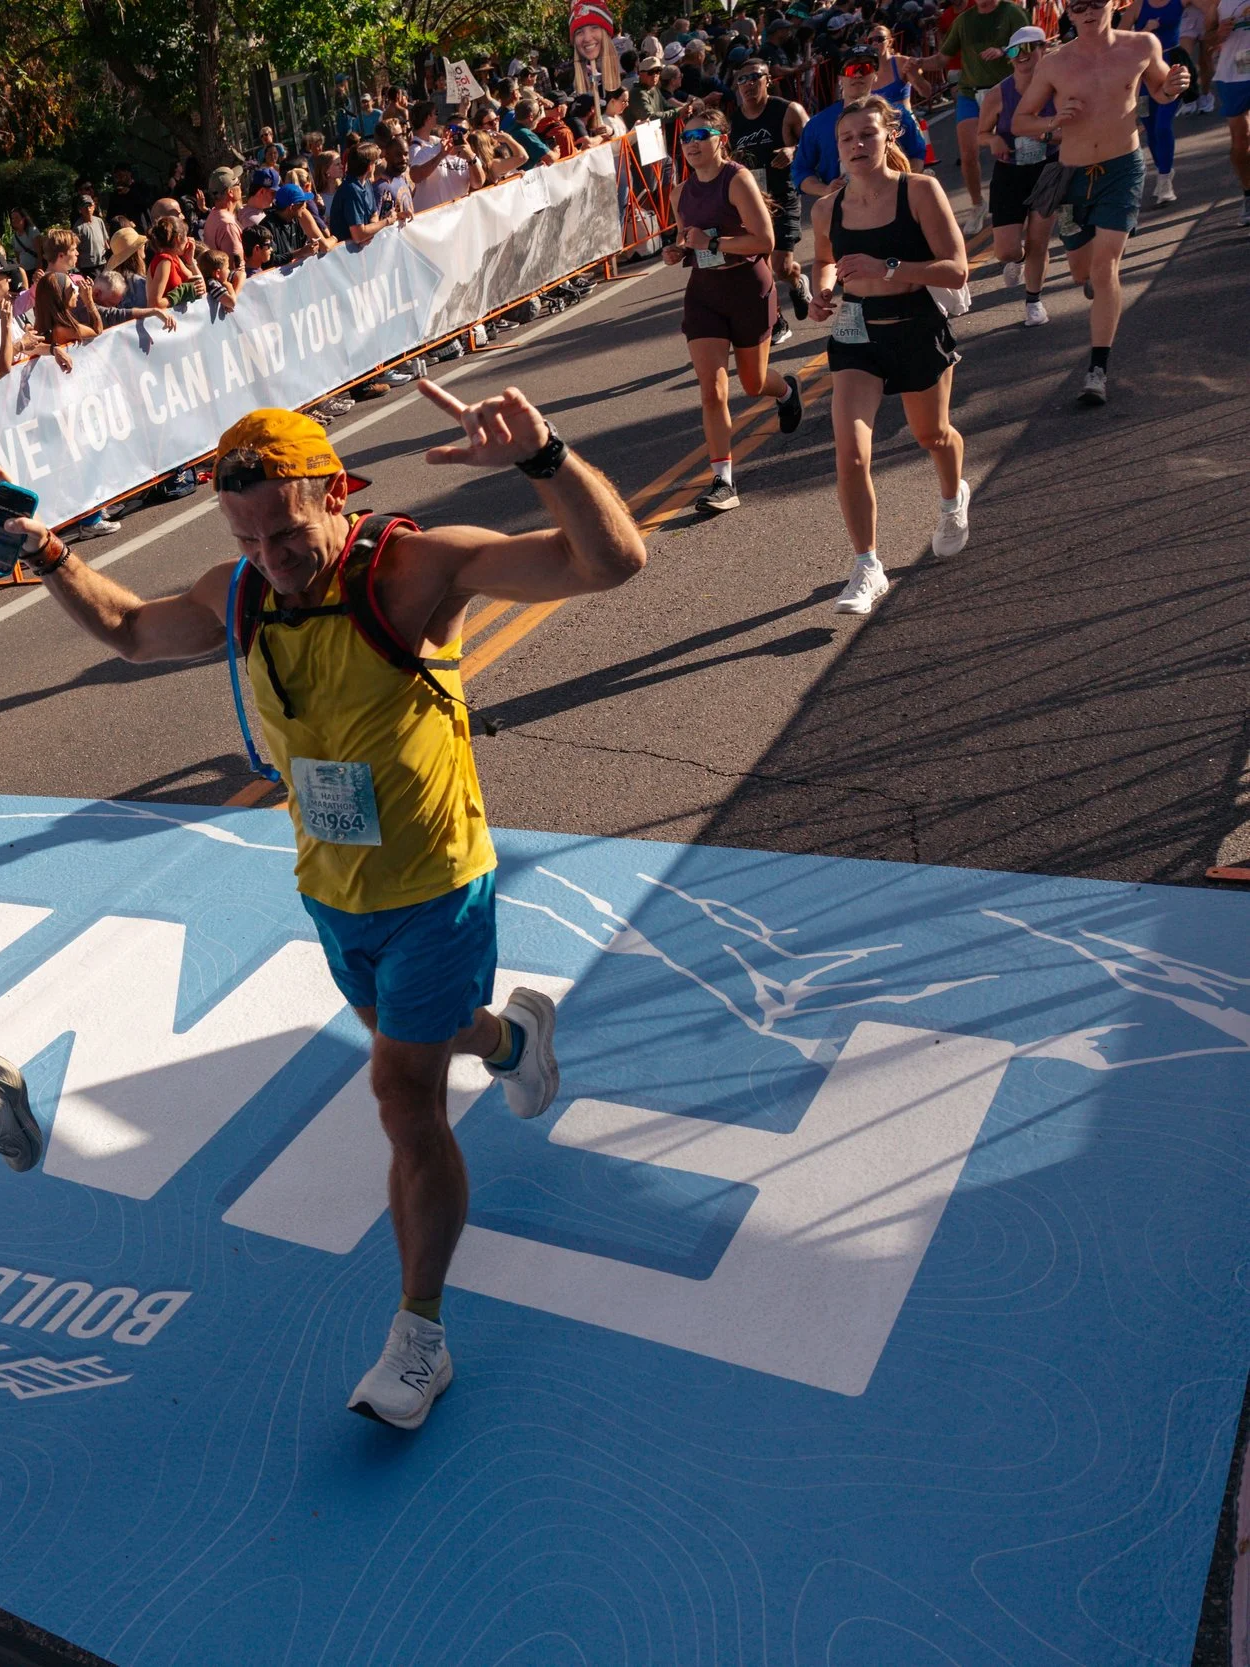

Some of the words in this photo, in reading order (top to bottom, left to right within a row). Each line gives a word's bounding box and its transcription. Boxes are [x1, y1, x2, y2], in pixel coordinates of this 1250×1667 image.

[54, 383, 132, 462] YOU
[222, 322, 286, 393] AND
[290, 295, 343, 360] YOU
[310, 810, 366, 832] 21964
